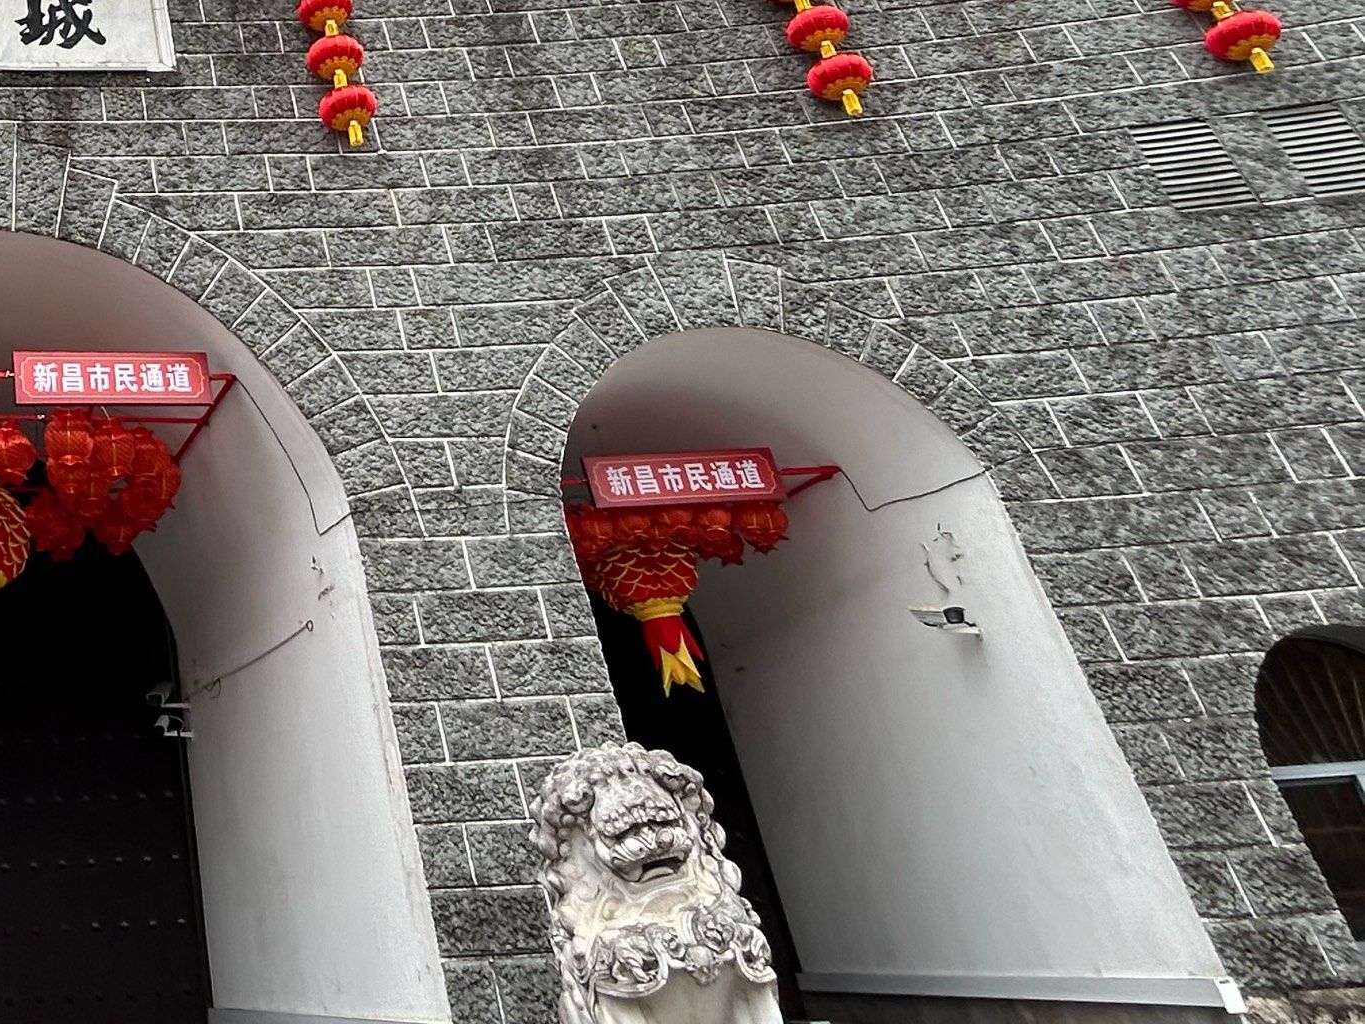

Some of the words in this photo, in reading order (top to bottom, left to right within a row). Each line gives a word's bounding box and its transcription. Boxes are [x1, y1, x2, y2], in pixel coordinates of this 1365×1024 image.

[33, 362, 192, 393] 新昌市民通道
[606, 460, 765, 496] 新昌市民通道
